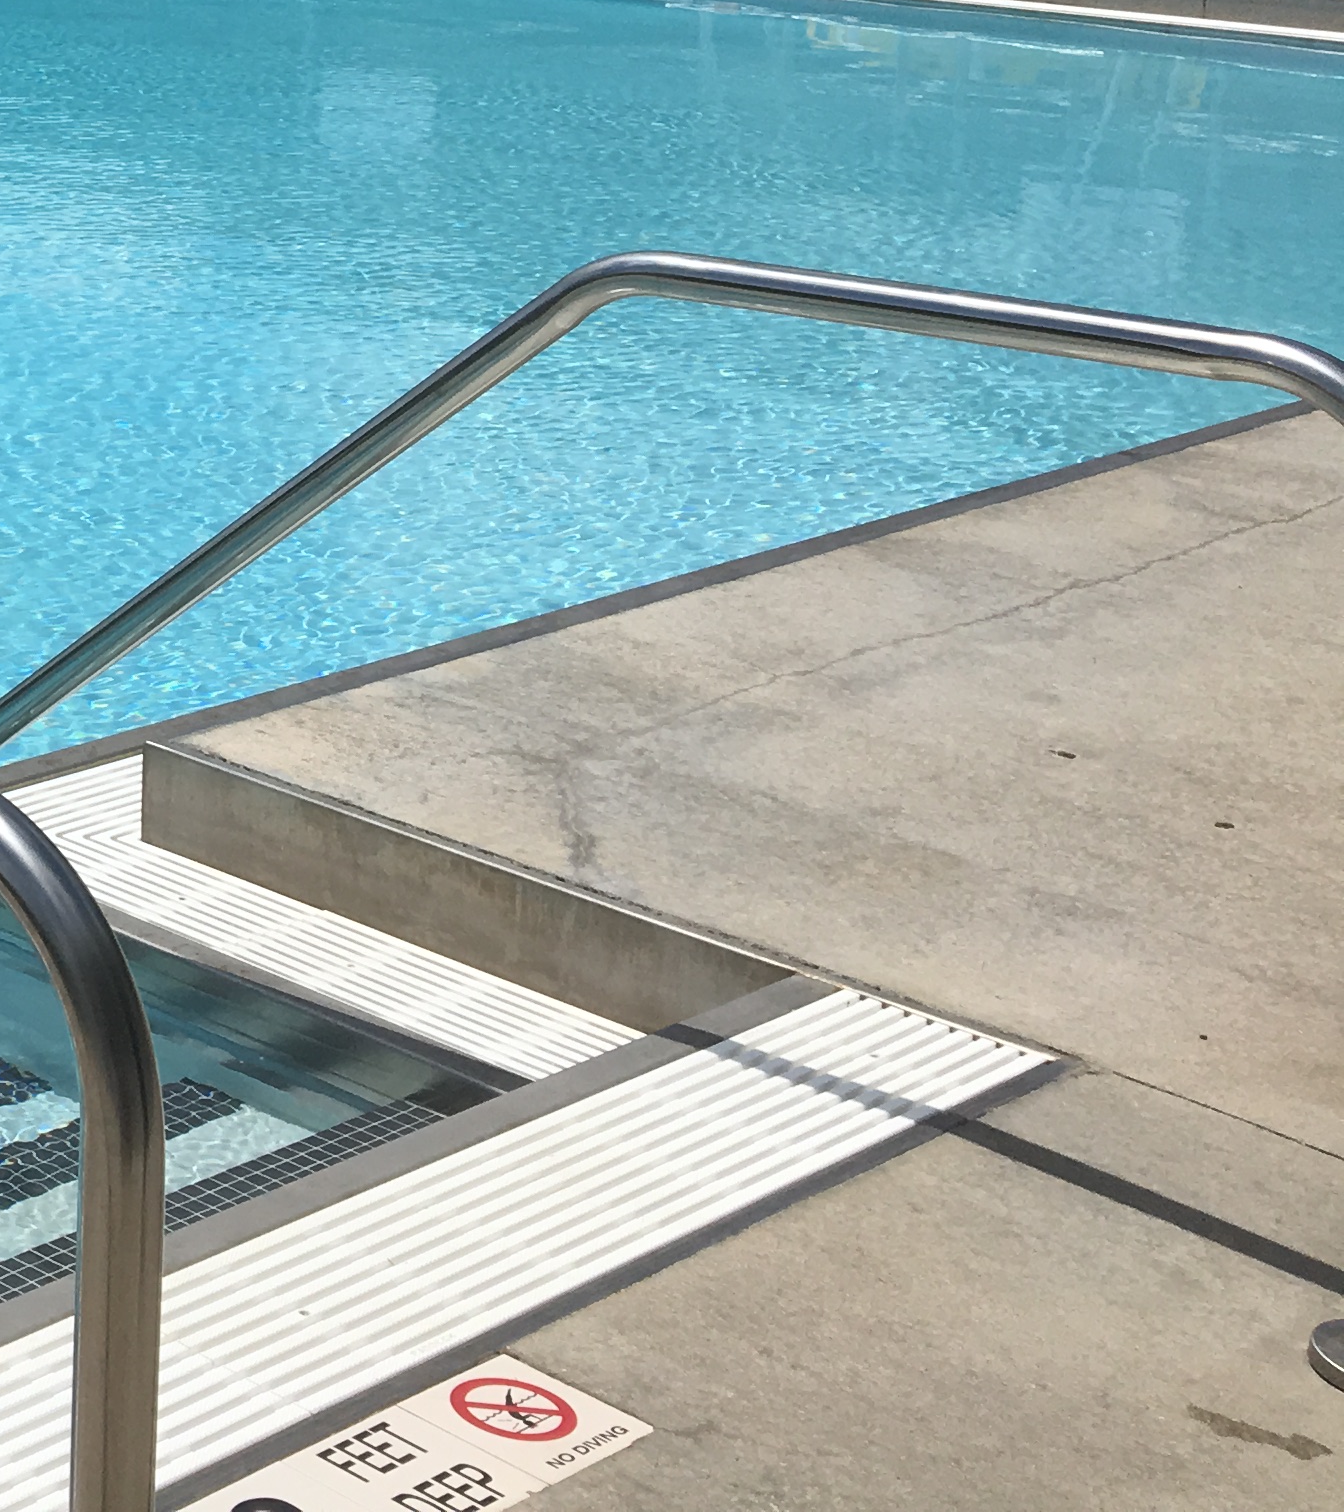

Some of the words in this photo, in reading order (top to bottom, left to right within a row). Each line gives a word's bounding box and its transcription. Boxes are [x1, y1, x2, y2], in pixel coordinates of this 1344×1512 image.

[315, 1421, 428, 1483] FEET
[545, 1452, 576, 1469] NO
[572, 1425, 630, 1456] DIVING
[392, 1462, 505, 1512] DEEP
